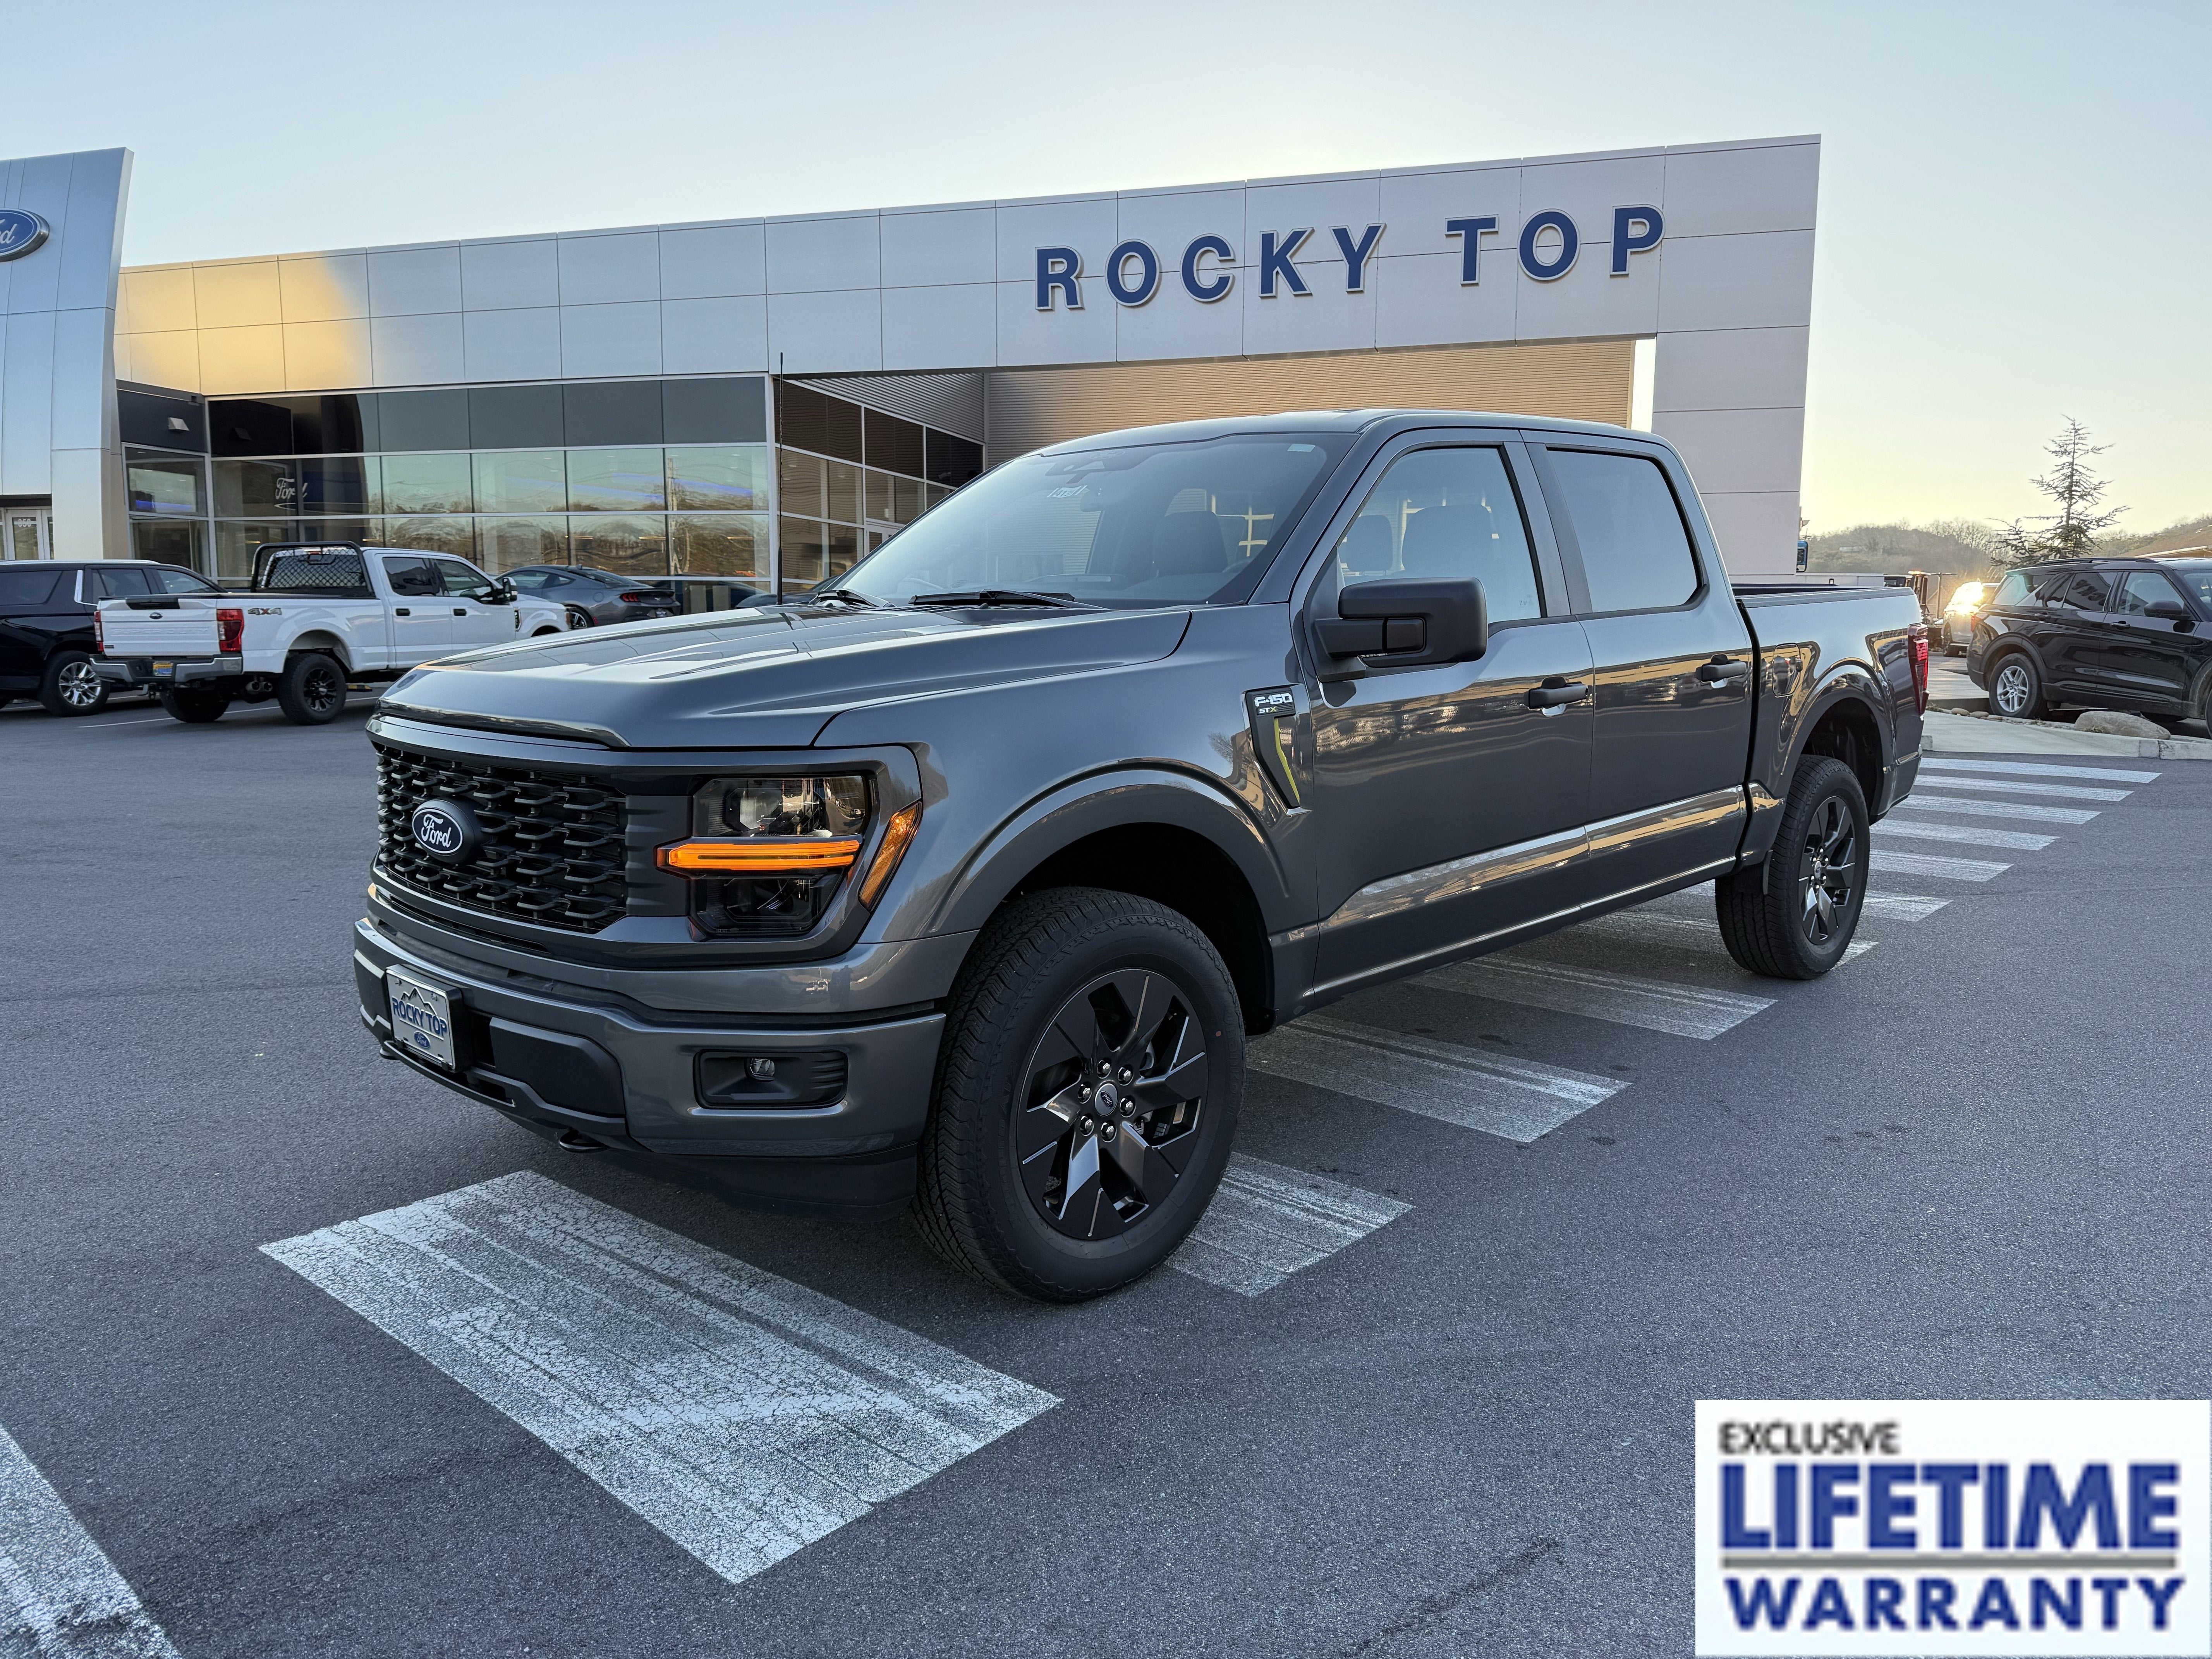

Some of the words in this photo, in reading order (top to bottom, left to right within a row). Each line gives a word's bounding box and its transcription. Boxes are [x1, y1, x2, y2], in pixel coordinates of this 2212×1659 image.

[1034, 223, 1386, 311] ROCKY
[1444, 204, 1665, 286] TOP
[1254, 693, 1293, 707] F-150
[421, 814, 452, 848] Ford
[392, 996, 425, 1027] ROCKY
[425, 1010, 447, 1037] TOP
[1103, 1093, 1112, 1106] Ford
